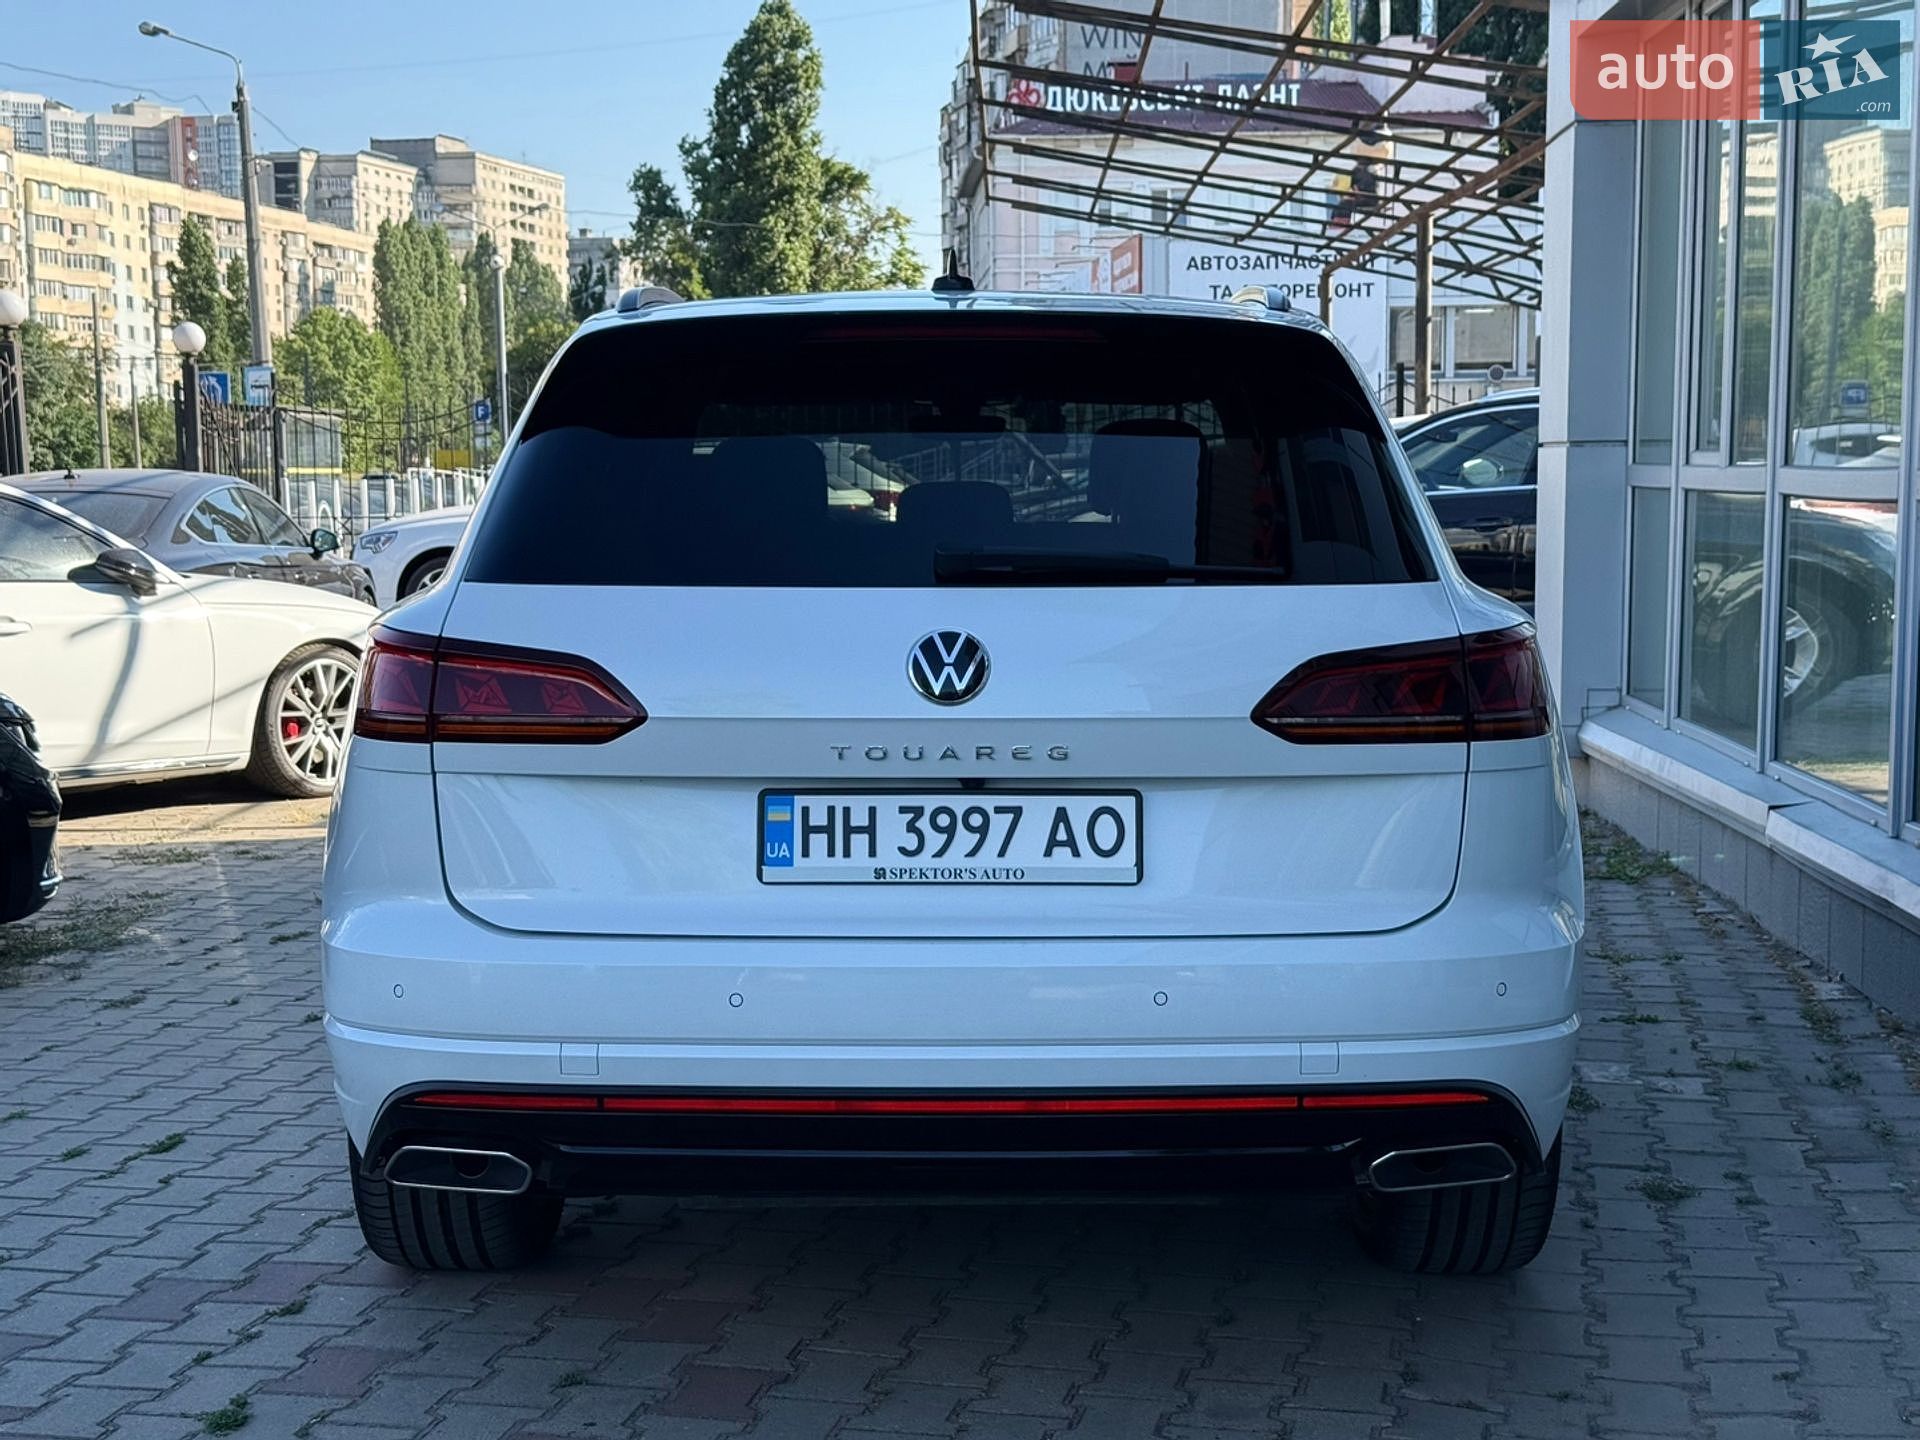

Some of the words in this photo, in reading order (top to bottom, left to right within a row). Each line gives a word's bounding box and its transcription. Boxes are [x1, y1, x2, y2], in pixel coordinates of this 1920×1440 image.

[1209, 284, 1234, 300] ТА
[830, 745, 1071, 761] TOUAREG
[801, 806, 877, 859] HH
[896, 806, 1024, 859] 3997
[1042, 806, 1126, 859] AO
[767, 842, 790, 859] UA
[889, 866, 977, 880] SPEKTOR'S
[980, 866, 1025, 880] AUTO
